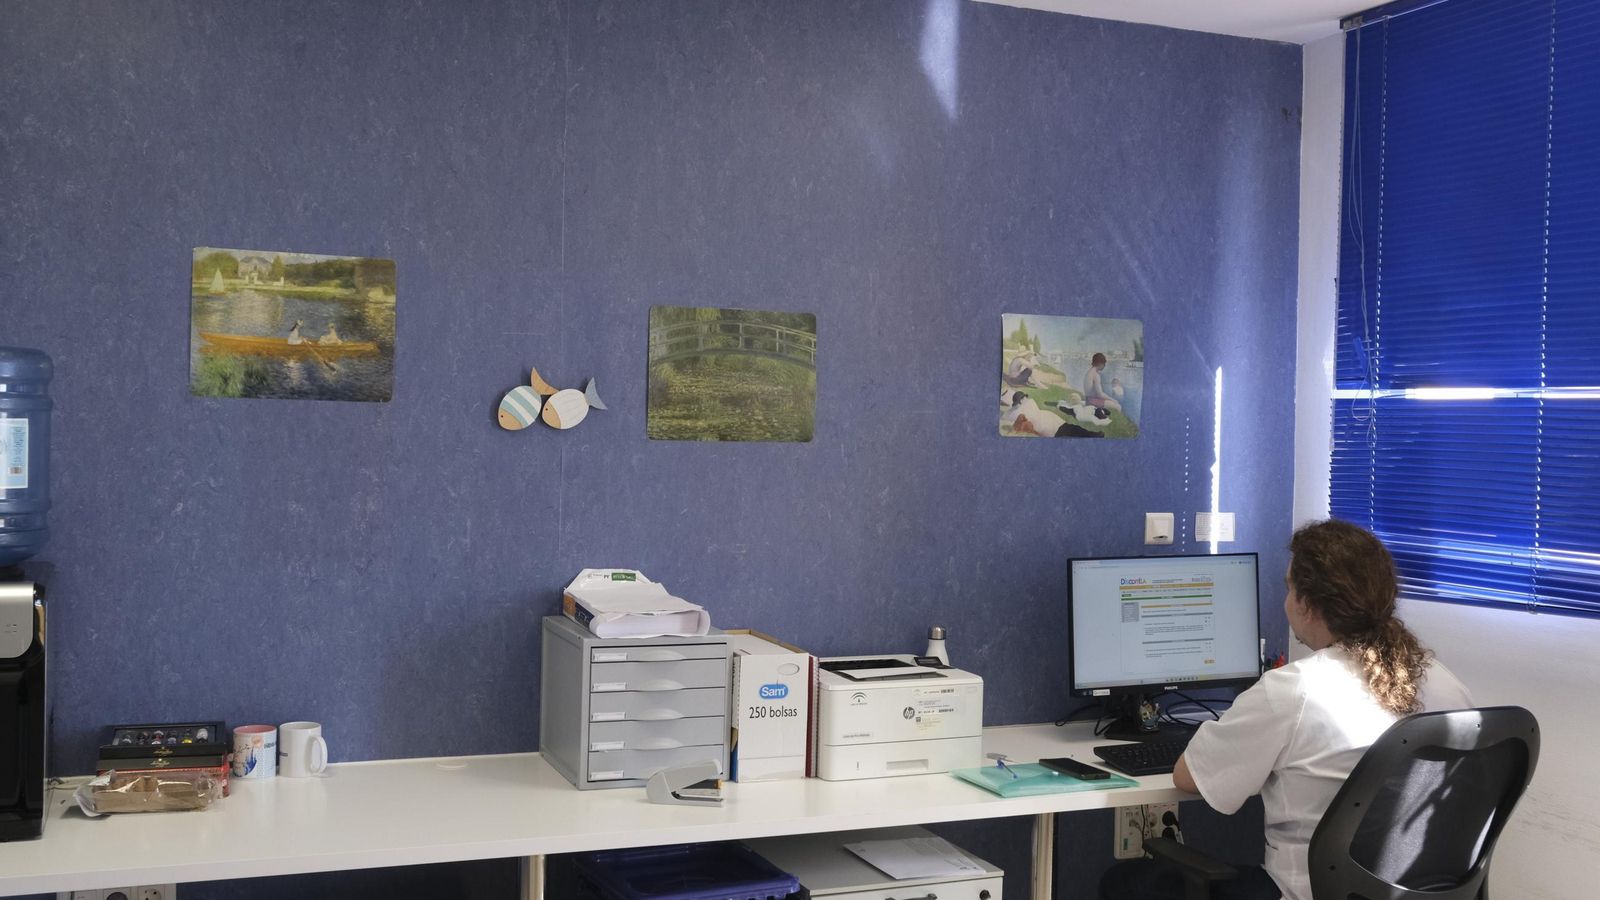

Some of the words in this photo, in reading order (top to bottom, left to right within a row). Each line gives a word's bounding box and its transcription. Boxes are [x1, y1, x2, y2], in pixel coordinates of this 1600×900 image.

[761, 686, 785, 697] Sam
[749, 706, 766, 719] 250
[769, 705, 798, 718] bolsas
